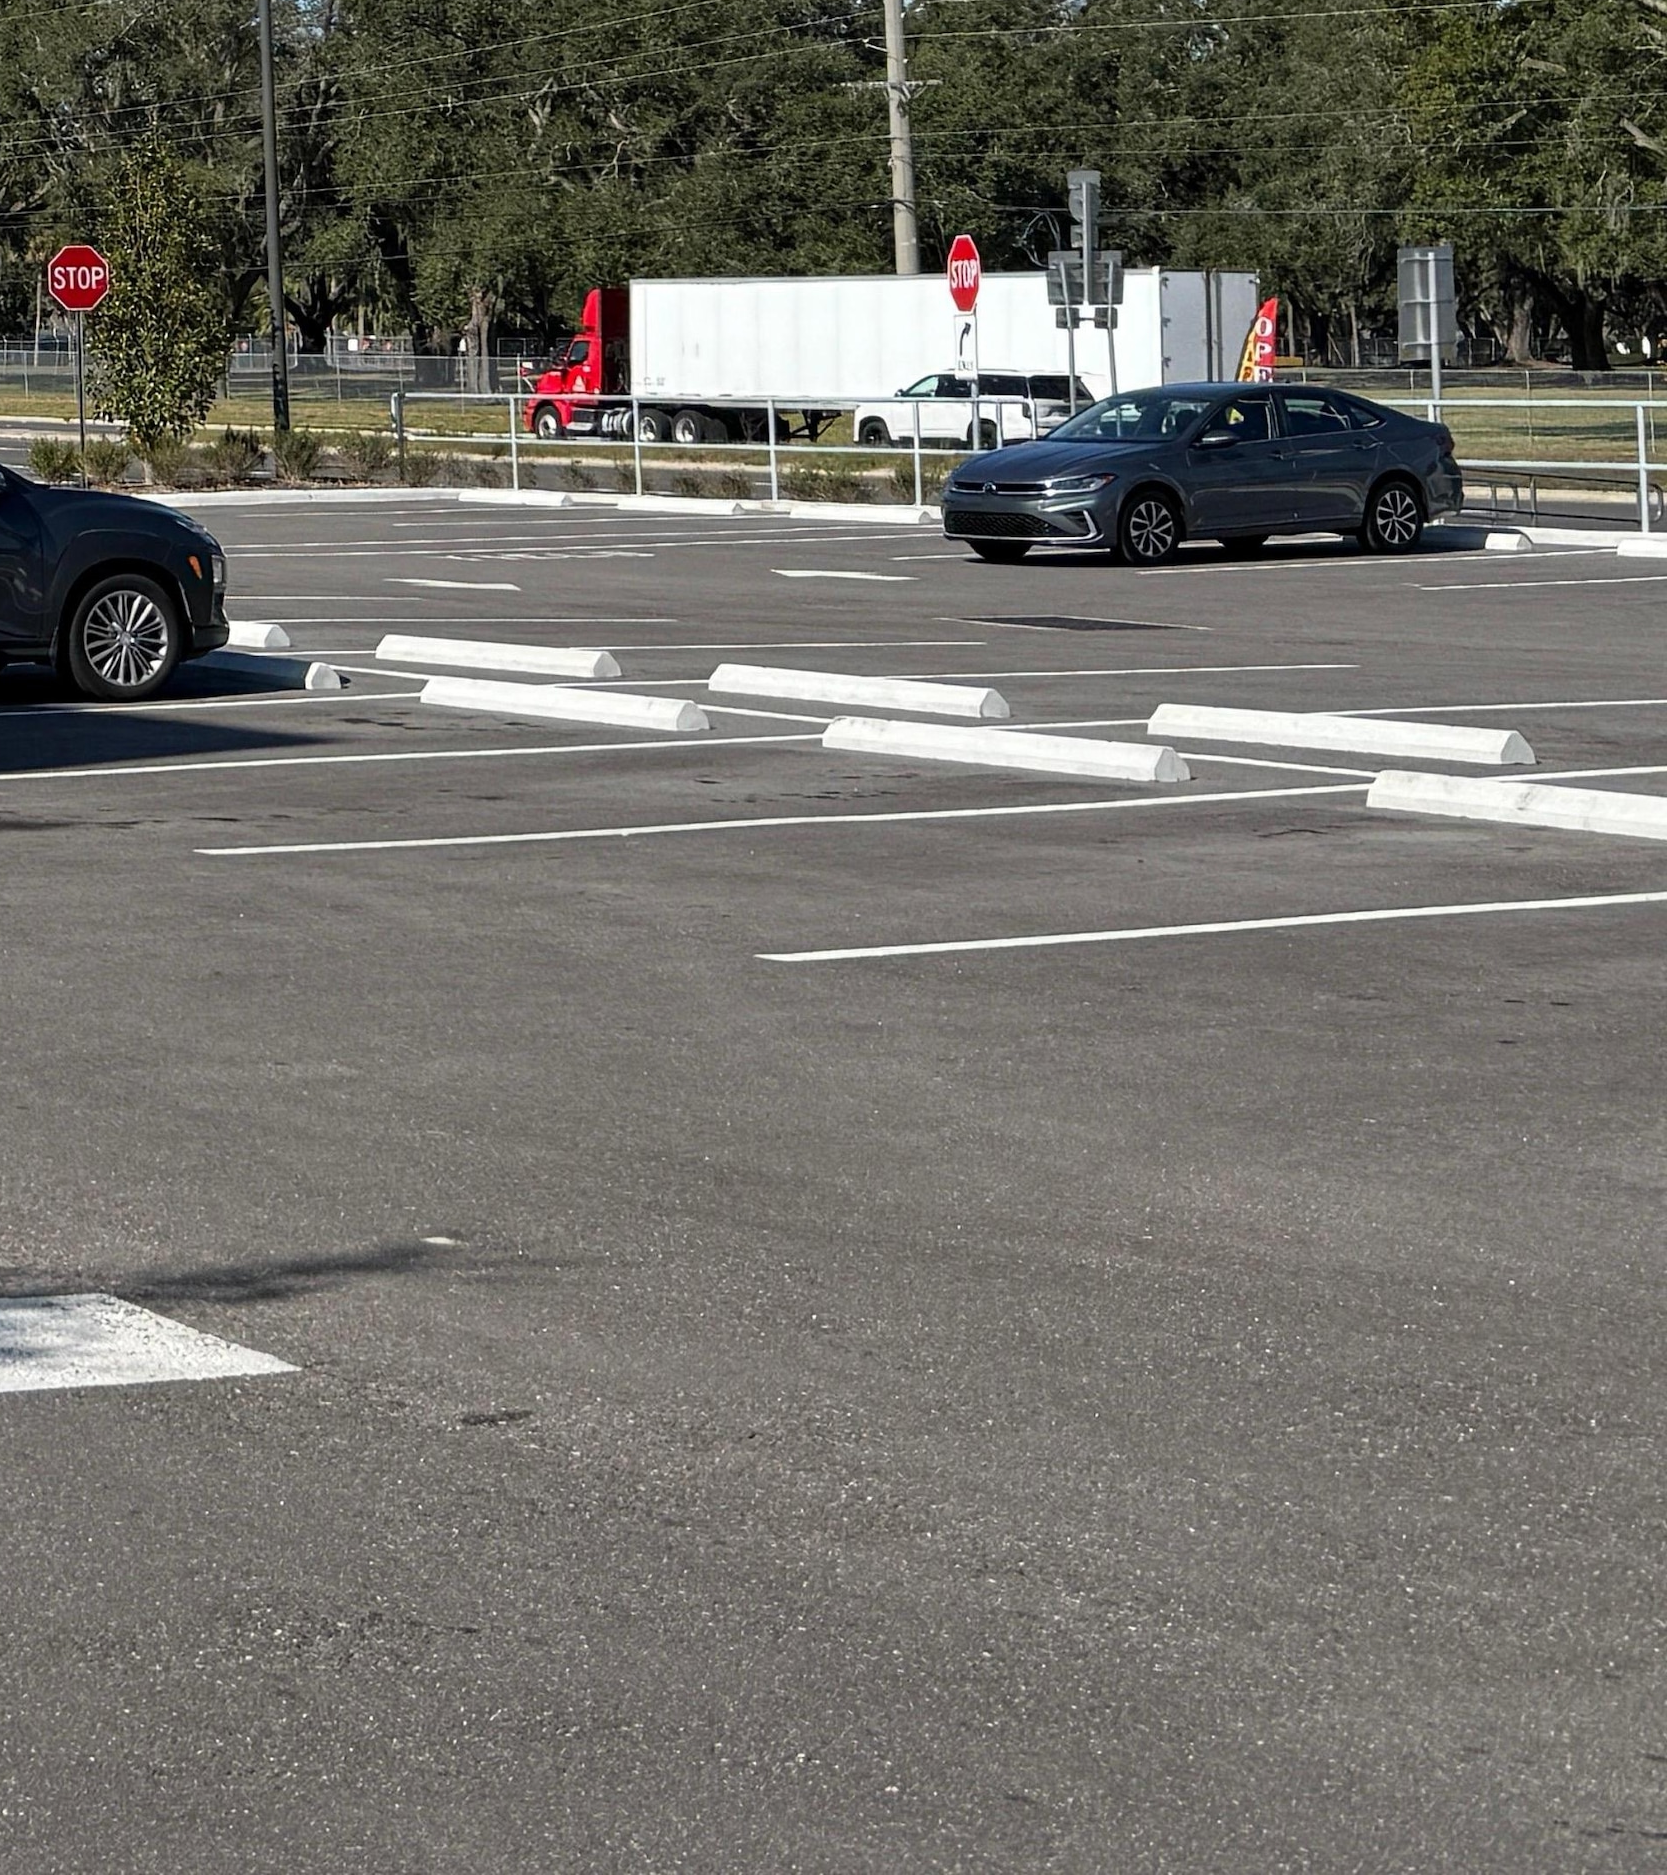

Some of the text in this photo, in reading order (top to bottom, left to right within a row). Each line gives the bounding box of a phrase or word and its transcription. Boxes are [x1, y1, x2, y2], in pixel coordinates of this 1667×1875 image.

[53, 266, 104, 289] STOP
[951, 259, 977, 288] STOP
[1254, 316, 1273, 383] OPE
